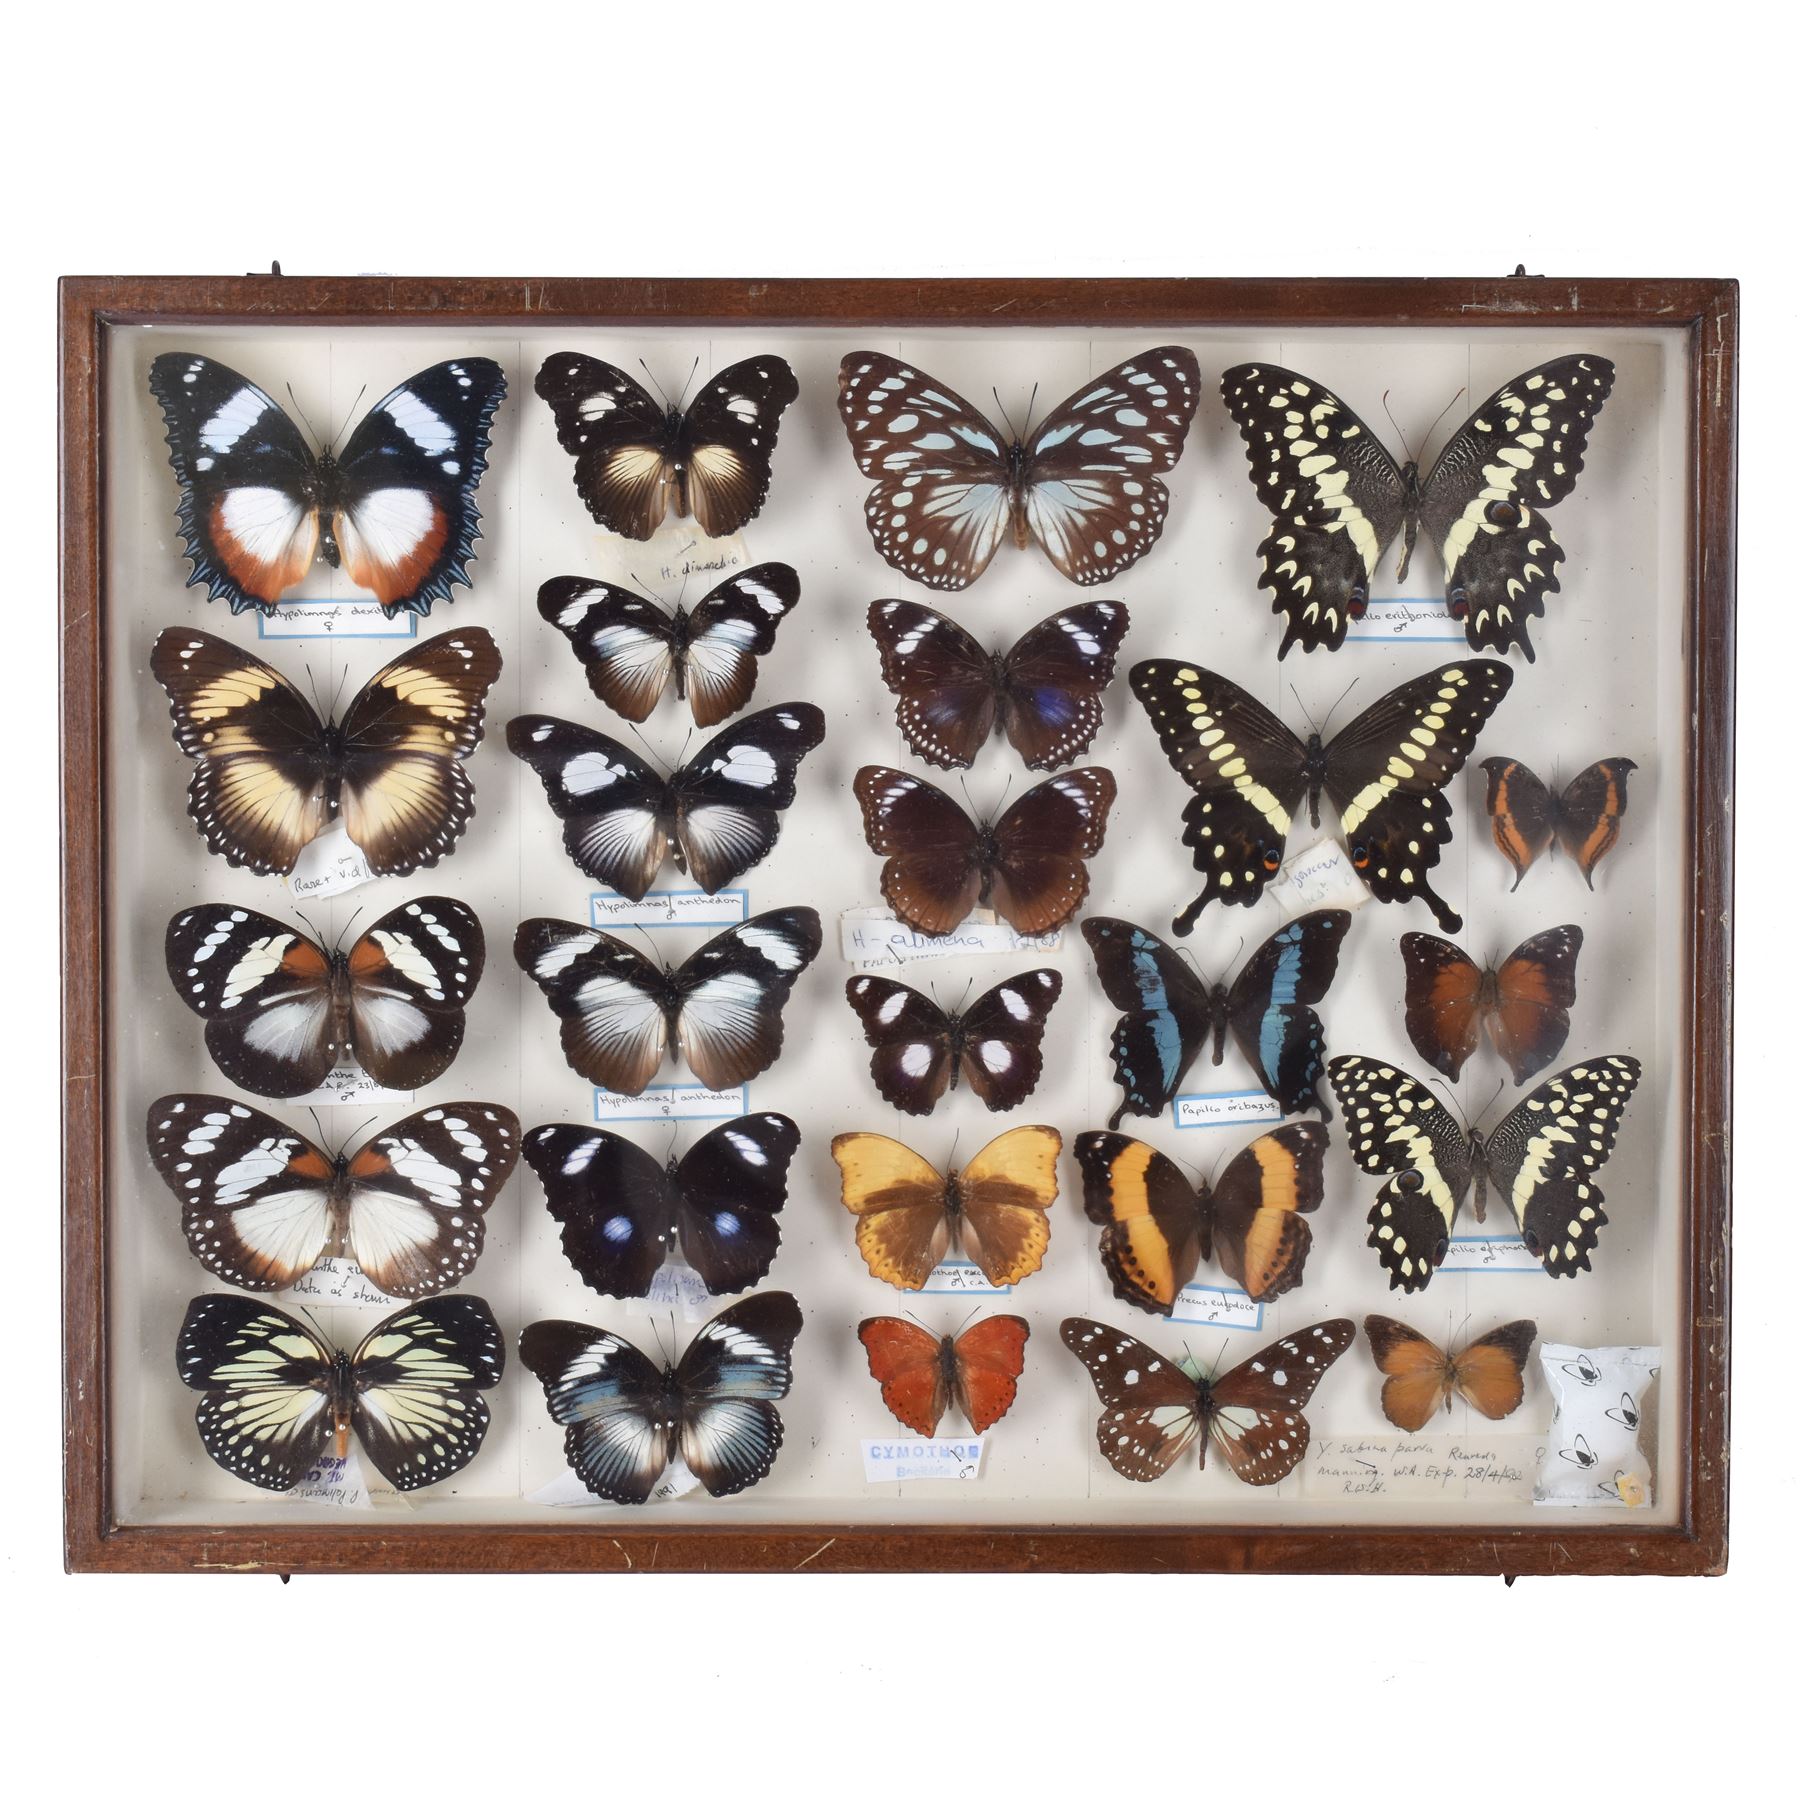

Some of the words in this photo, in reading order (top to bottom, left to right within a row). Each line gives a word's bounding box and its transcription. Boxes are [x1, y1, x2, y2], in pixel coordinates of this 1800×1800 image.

[596, 899, 669, 914] Hypolimnas
[677, 896, 741, 906] anthedon
[600, 1095, 671, 1109] Hypolimnas
[680, 1092, 741, 1102] anthedon
